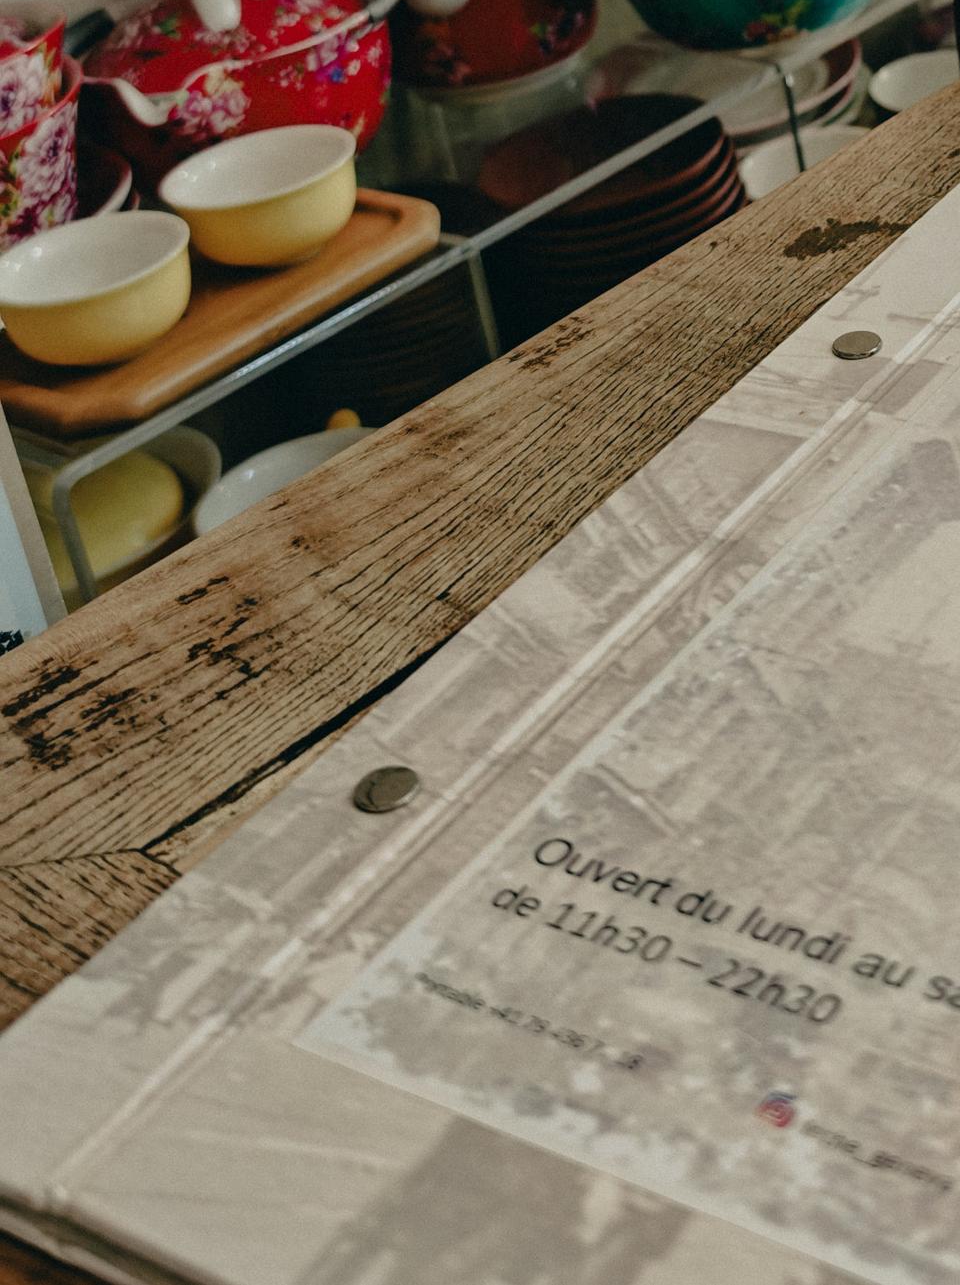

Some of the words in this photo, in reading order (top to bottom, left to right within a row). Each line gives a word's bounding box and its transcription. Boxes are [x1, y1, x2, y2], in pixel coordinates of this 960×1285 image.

[491, 885, 541, 917] de
[546, 902, 673, 963] 11h30
[706, 959, 843, 1023] 22h30
[534, 837, 673, 906] Ouvert
[676, 889, 733, 924] du
[736, 906, 851, 965] lundi
[852, 952, 916, 988] au
